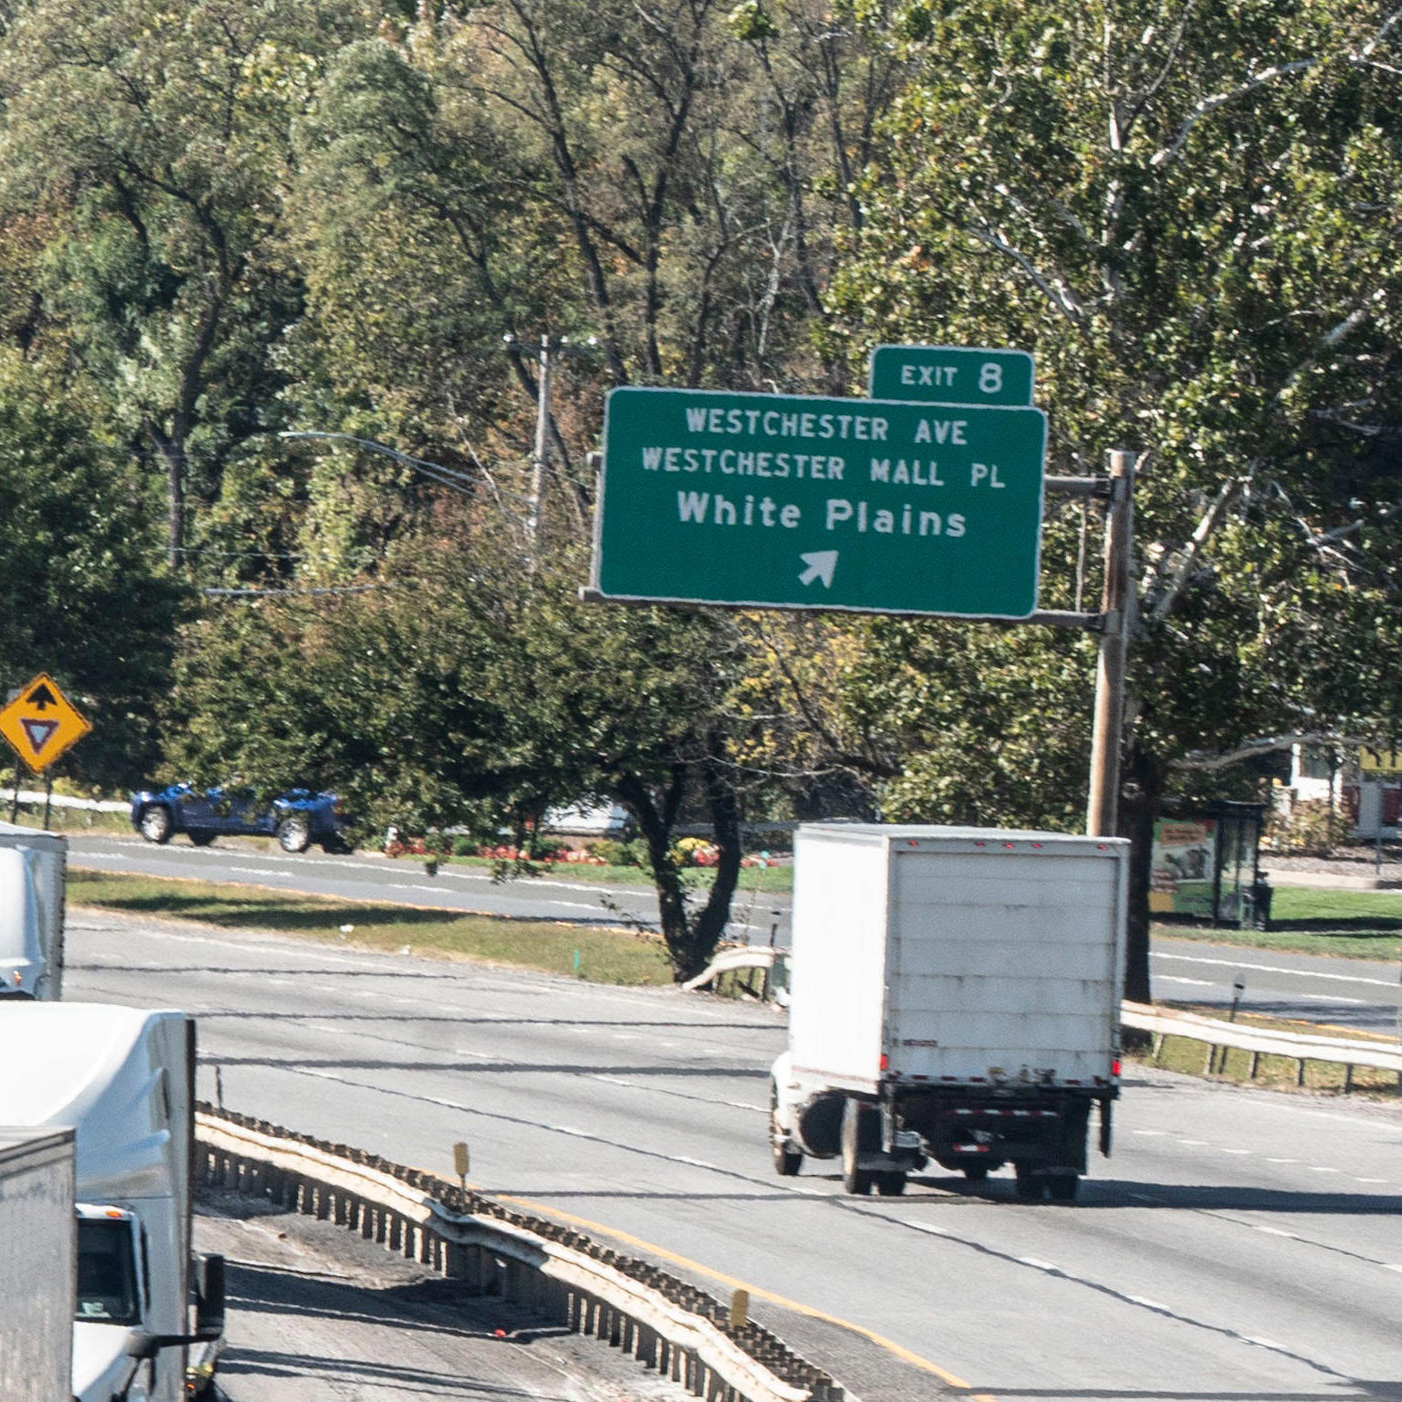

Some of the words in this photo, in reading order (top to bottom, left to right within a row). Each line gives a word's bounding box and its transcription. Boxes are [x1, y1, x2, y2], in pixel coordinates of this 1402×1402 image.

[900, 364, 959, 388] EXIT
[977, 362, 1004, 395] 8
[685, 407, 889, 442] WESTCHESTER
[913, 419, 969, 446] AVE
[641, 447, 845, 481] WESTCHESTER
[870, 457, 945, 488] MALL
[970, 463, 1007, 489] PL
[676, 490, 802, 530] White
[825, 498, 968, 538] Plains
